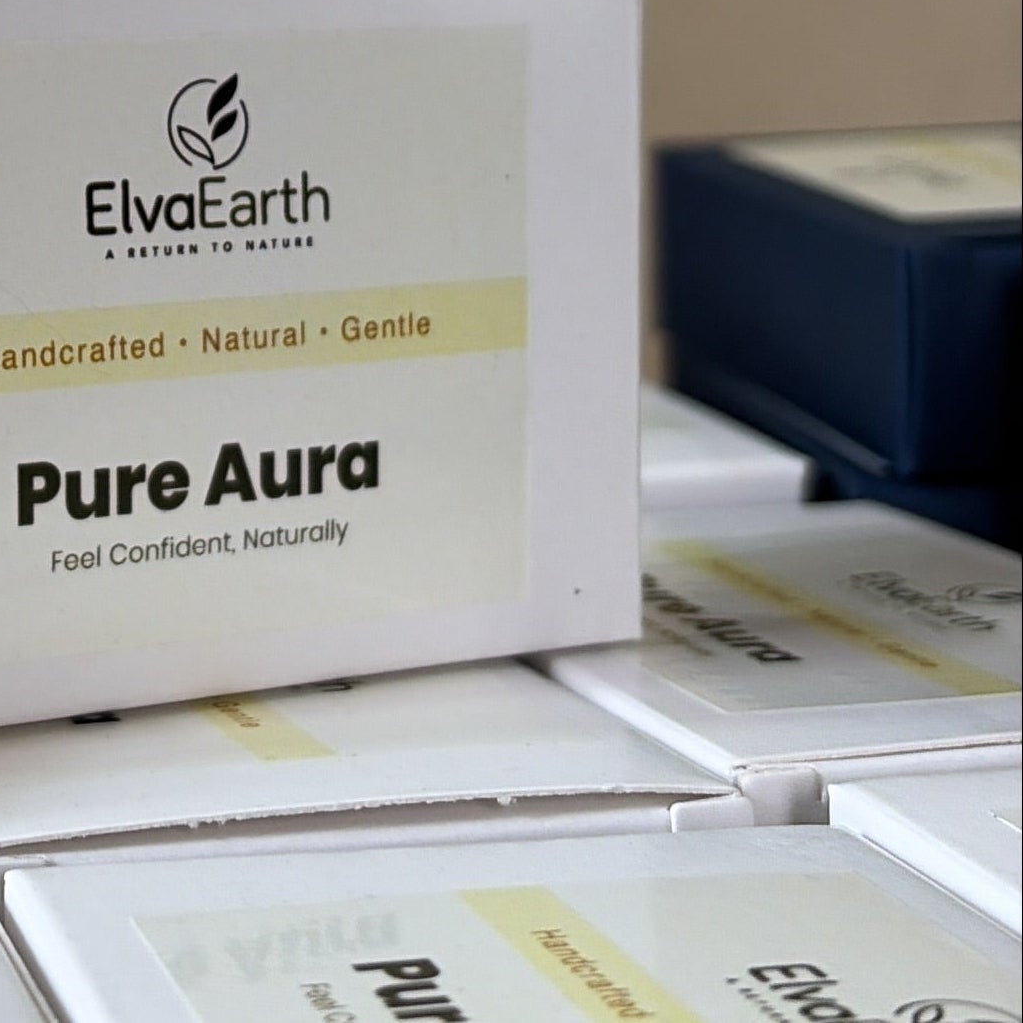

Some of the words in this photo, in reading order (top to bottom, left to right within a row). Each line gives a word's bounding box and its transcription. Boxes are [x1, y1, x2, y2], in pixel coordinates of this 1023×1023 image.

[85, 170, 331, 236] ElvaEarth
[105, 249, 115, 260] A
[128, 243, 199, 259] RETURN
[211, 241, 233, 253] TO
[246, 236, 314, 251] NATURE
[201, 321, 306, 354] Natural
[340, 312, 432, 342] Gentle
[17, 460, 191, 527] Pure
[204, 440, 380, 506] Aura
[51, 545, 101, 573] Feel
[109, 532, 236, 566] Confident,
[243, 518, 350, 550] Naturally
[681, 616, 803, 663] Aura
[530, 928, 658, 1020] Handcrafted
[748, 963, 891, 1023] Elva
